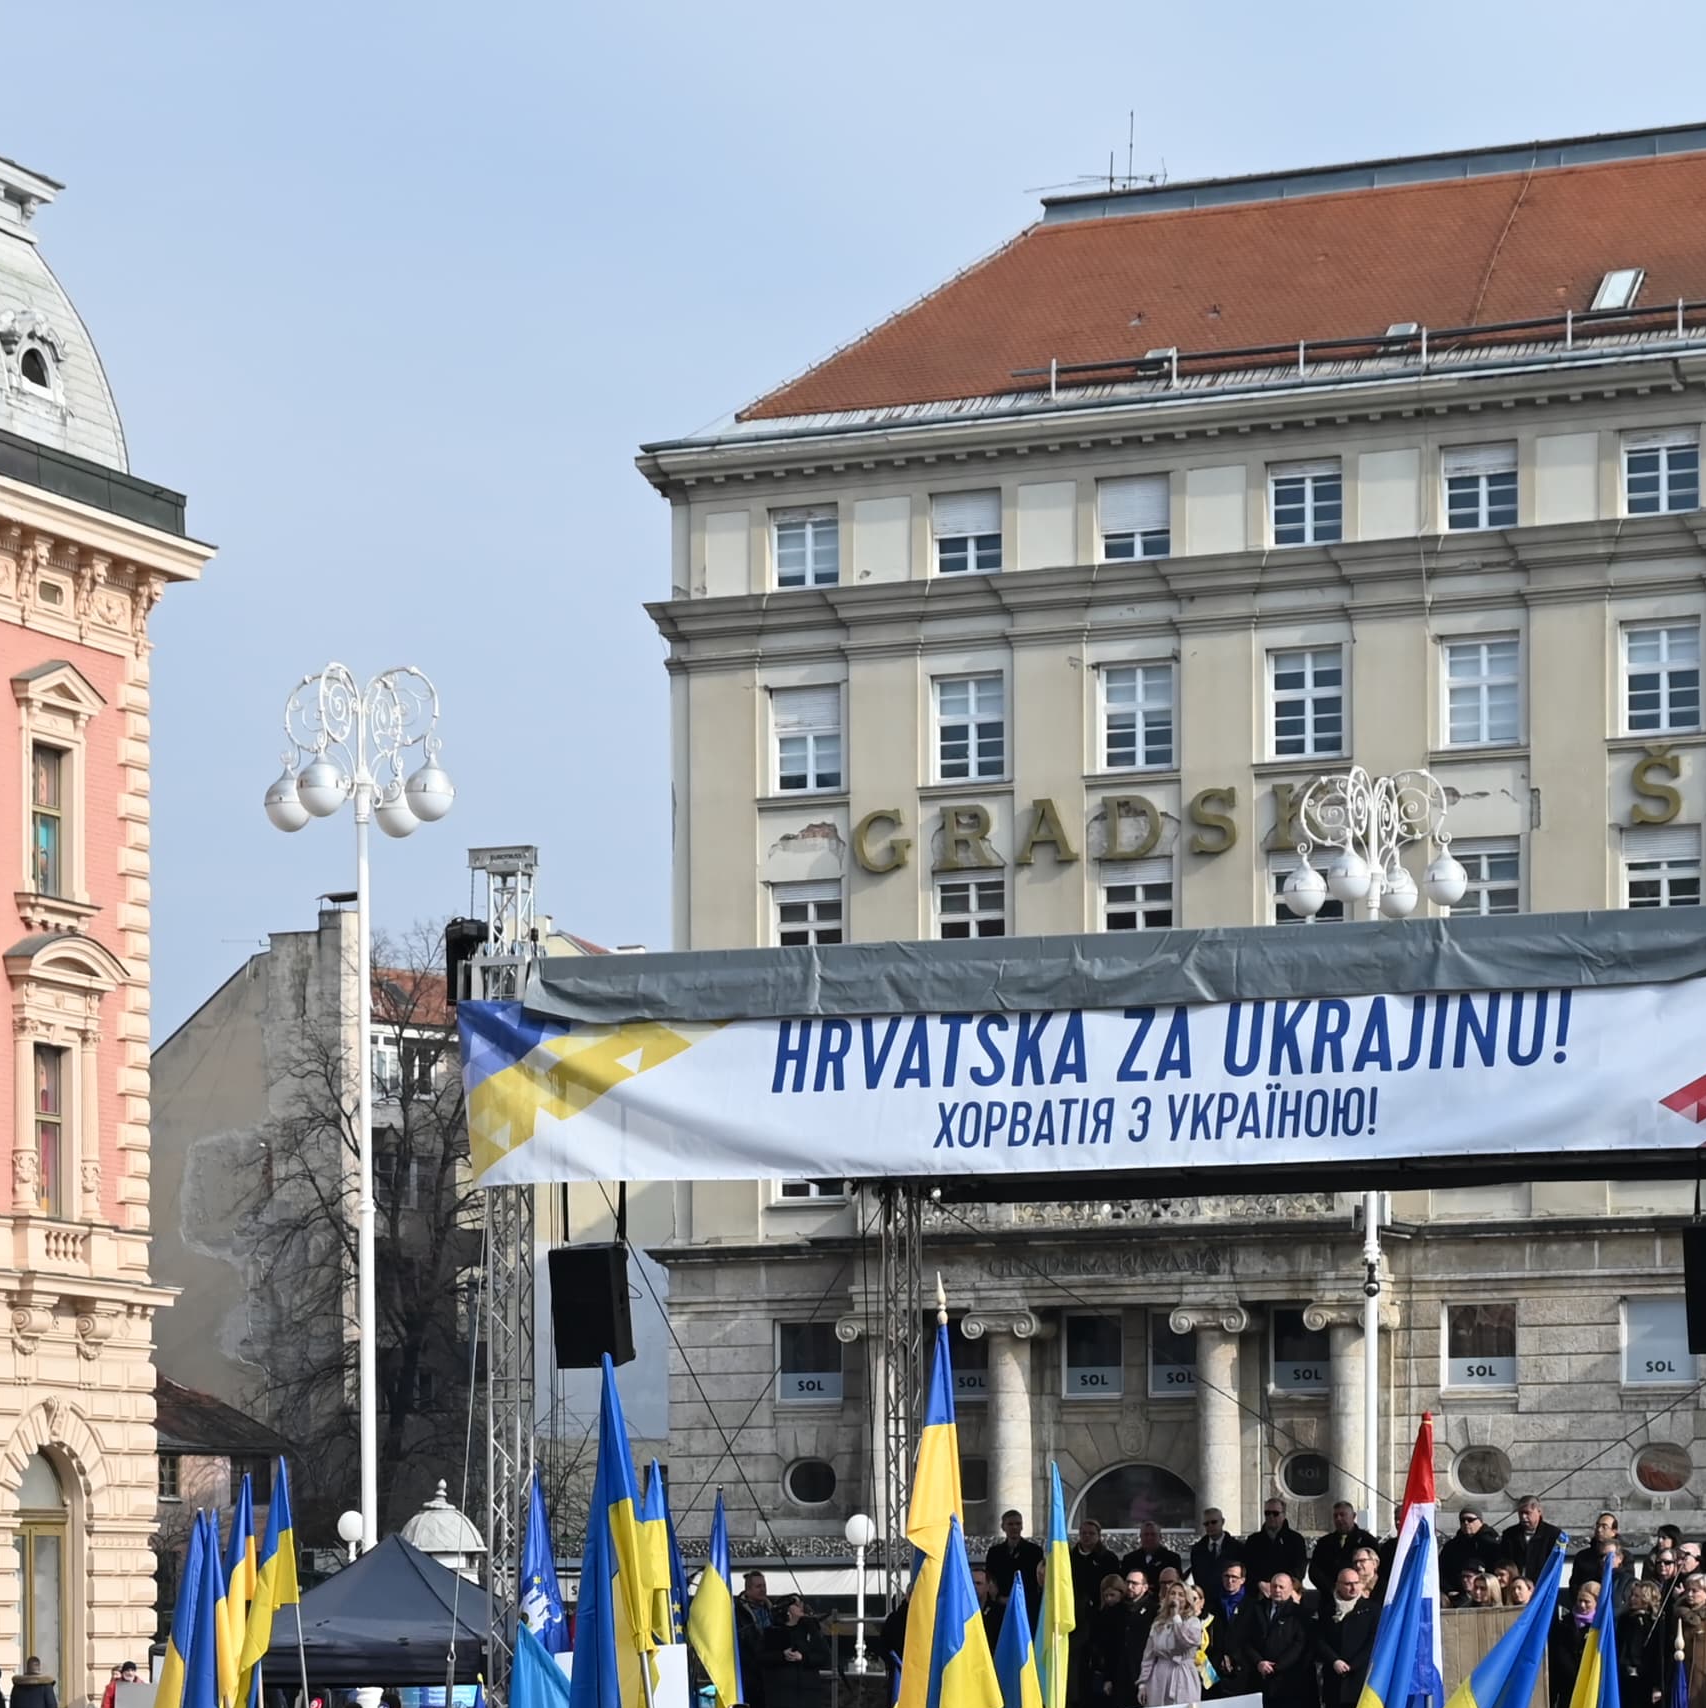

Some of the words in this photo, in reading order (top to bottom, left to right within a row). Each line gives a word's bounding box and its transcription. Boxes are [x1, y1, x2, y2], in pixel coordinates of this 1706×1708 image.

[771, 1008, 1088, 1094] HRVATSKA
[1116, 1005, 1191, 1082] ZA
[1223, 988, 1573, 1077] UKRAJINU!
[933, 1097, 1115, 1149] ХОРВАТІЯ
[1127, 1096, 1152, 1143] З
[1167, 1082, 1379, 1142] УКРАЇНОЮ!
[1466, 1365, 1497, 1378] SOL
[1645, 1360, 1676, 1373] SOL
[1080, 1373, 1109, 1387] SOL
[1166, 1371, 1195, 1384] SOL
[1293, 1368, 1323, 1381] SOL
[797, 1379, 825, 1392] SOL
[958, 1375, 986, 1389] SOL
